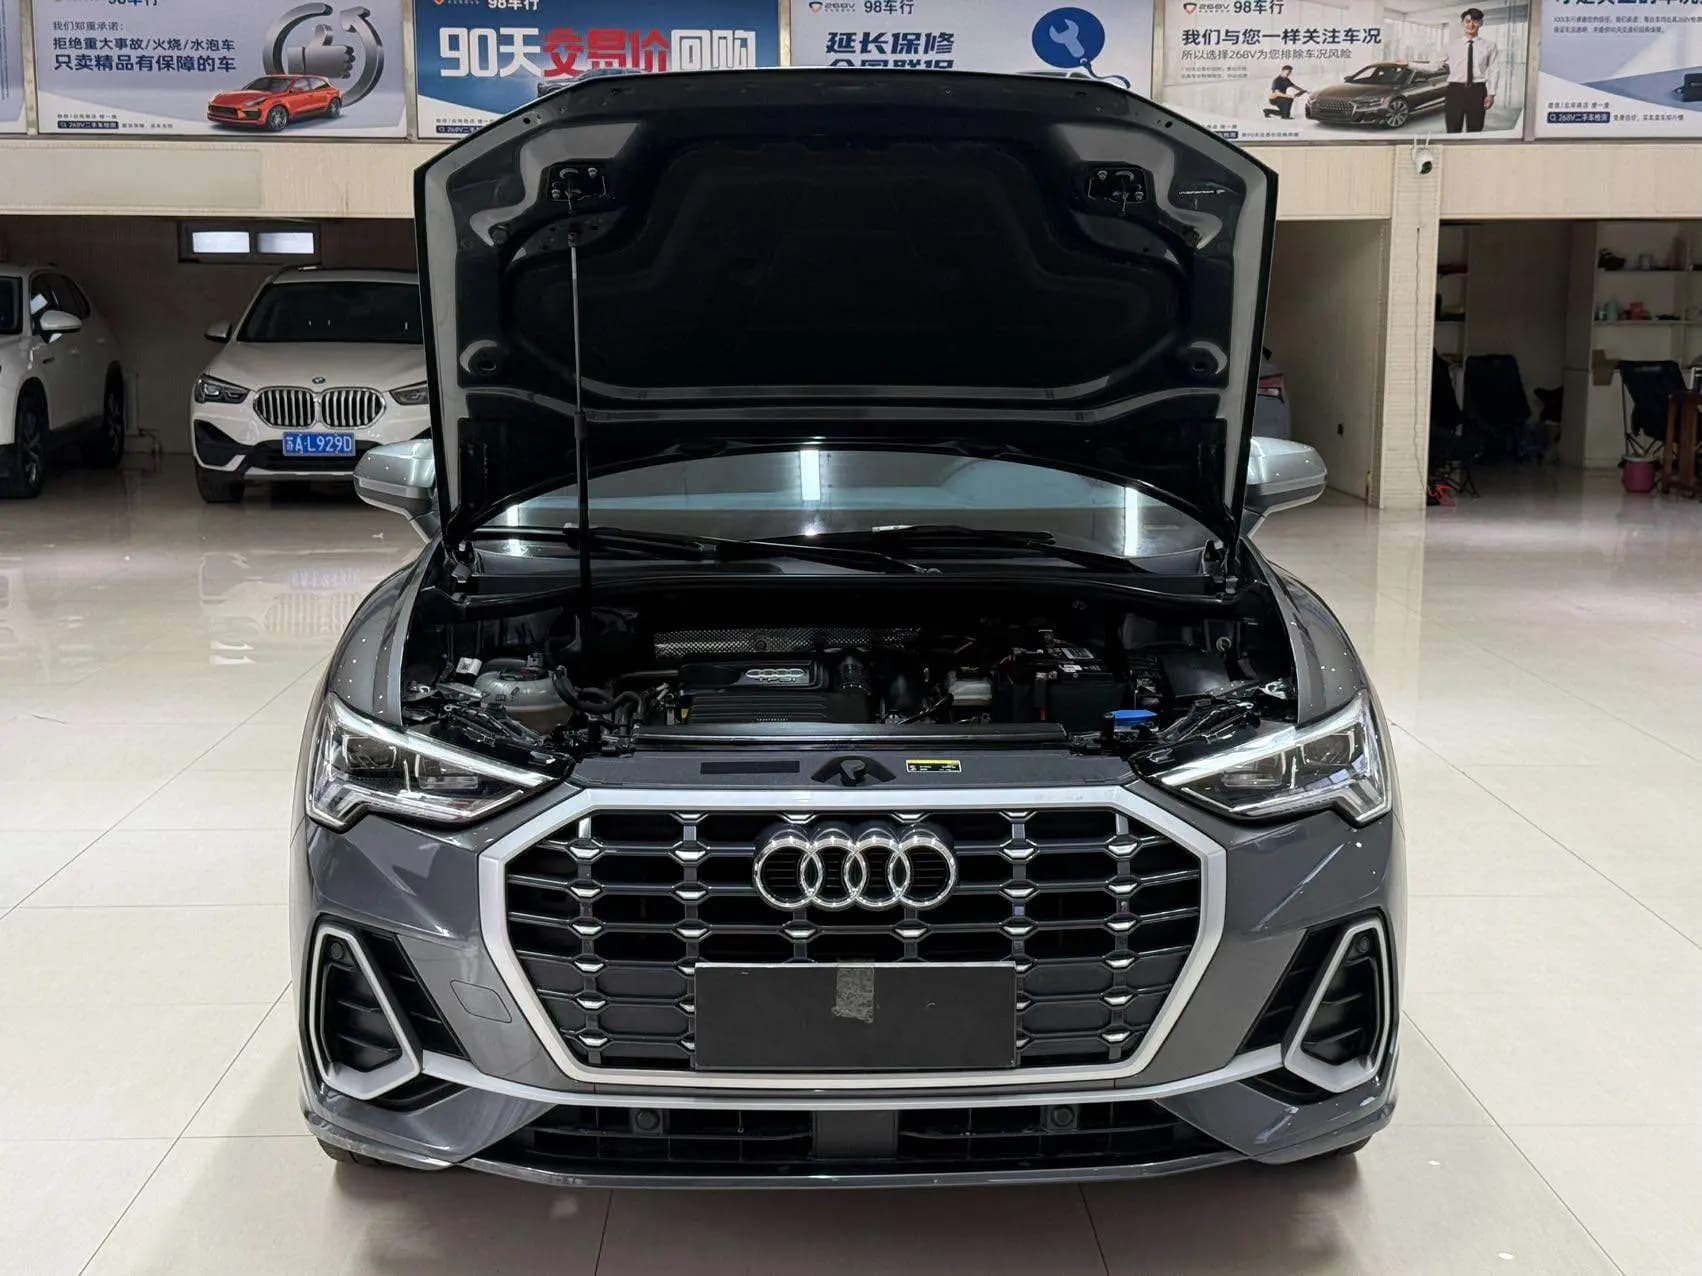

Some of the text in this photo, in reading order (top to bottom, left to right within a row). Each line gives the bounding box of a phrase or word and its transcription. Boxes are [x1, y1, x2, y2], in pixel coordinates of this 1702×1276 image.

[864, 0, 914, 14] 98车行
[1233, 0, 1284, 14] 98车行
[53, 37, 235, 51] 拒绝重大事故/火烧/水泡车
[826, 32, 954, 54] 延长保修
[1182, 28, 1382, 45] 我们与您一样关注车况
[439, 27, 757, 77] 90天交易价回购
[1181, 48, 1352, 60] 所以选择268V为您排除车况风险
[54, 54, 236, 72] 只卖精品有保障的车
